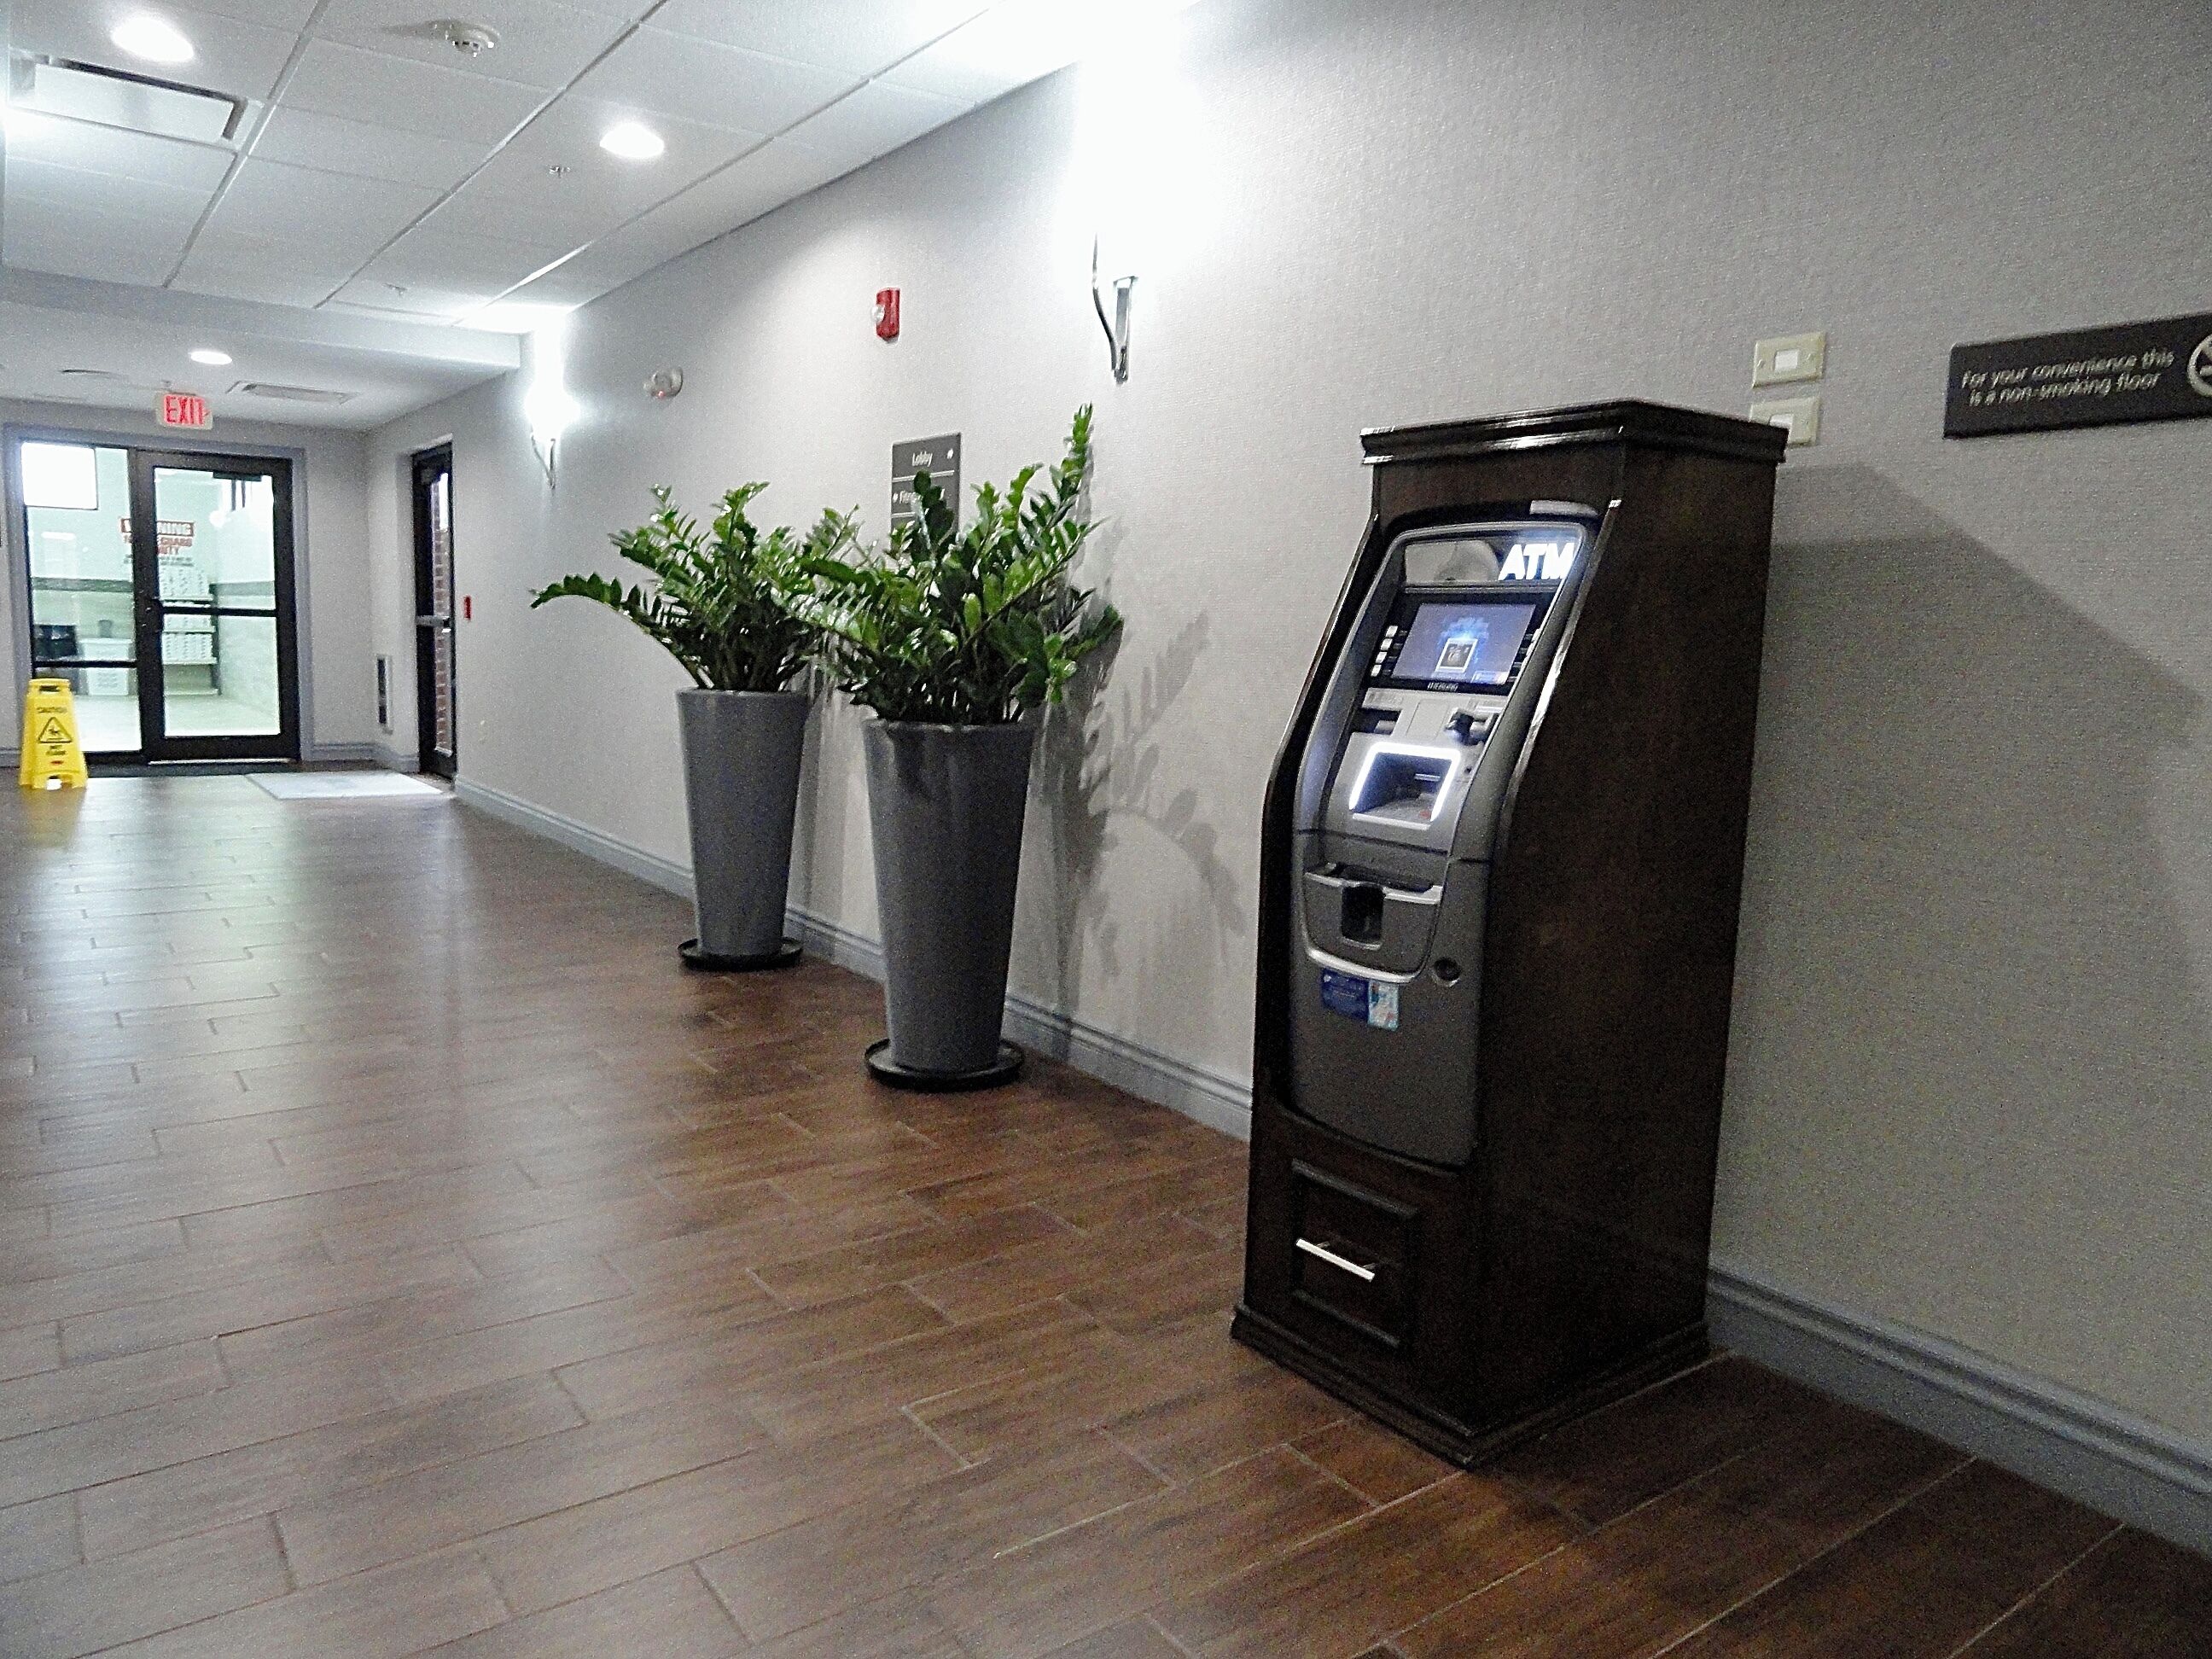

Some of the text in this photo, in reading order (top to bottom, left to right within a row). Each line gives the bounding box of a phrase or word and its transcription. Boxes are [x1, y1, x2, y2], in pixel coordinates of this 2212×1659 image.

[1961, 369, 1988, 388] For
[1991, 367, 2029, 390] your
[2142, 348, 2175, 370] this
[1984, 390, 1997, 406] a
[2116, 372, 2163, 393] floor
[165, 394, 205, 426] EXIT
[1498, 542, 1575, 580] ATM
